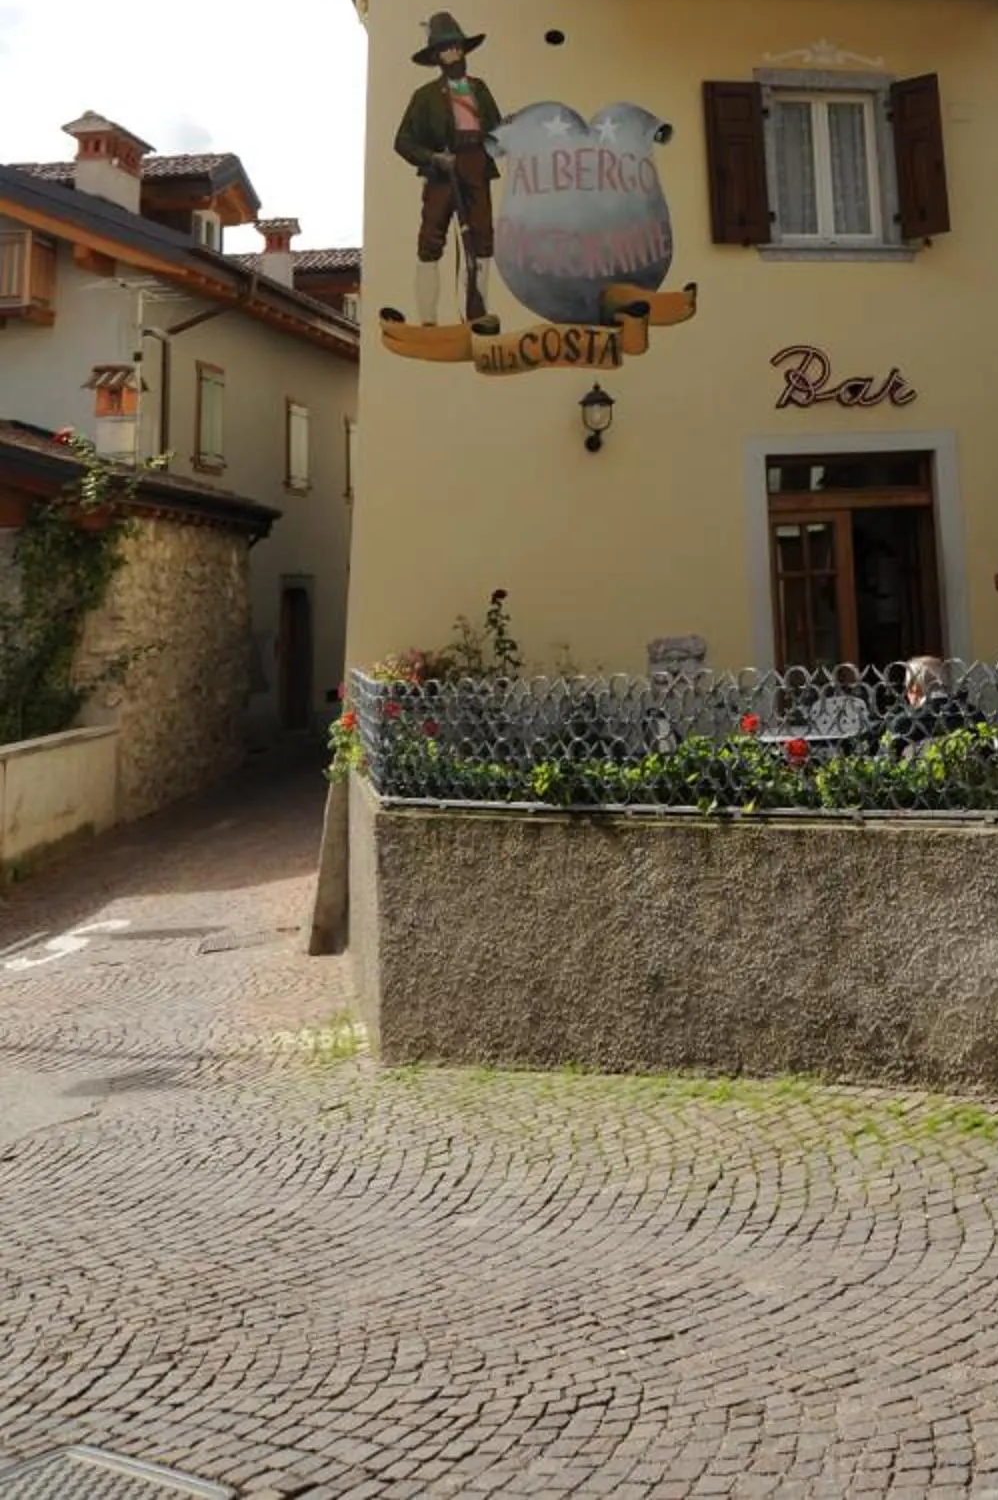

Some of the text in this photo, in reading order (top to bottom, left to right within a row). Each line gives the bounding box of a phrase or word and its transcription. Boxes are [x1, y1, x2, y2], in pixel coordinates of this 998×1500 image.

[511, 147, 658, 196] ALBERGO
[481, 327, 620, 372] alla COSTA
[770, 344, 918, 408] Bar
